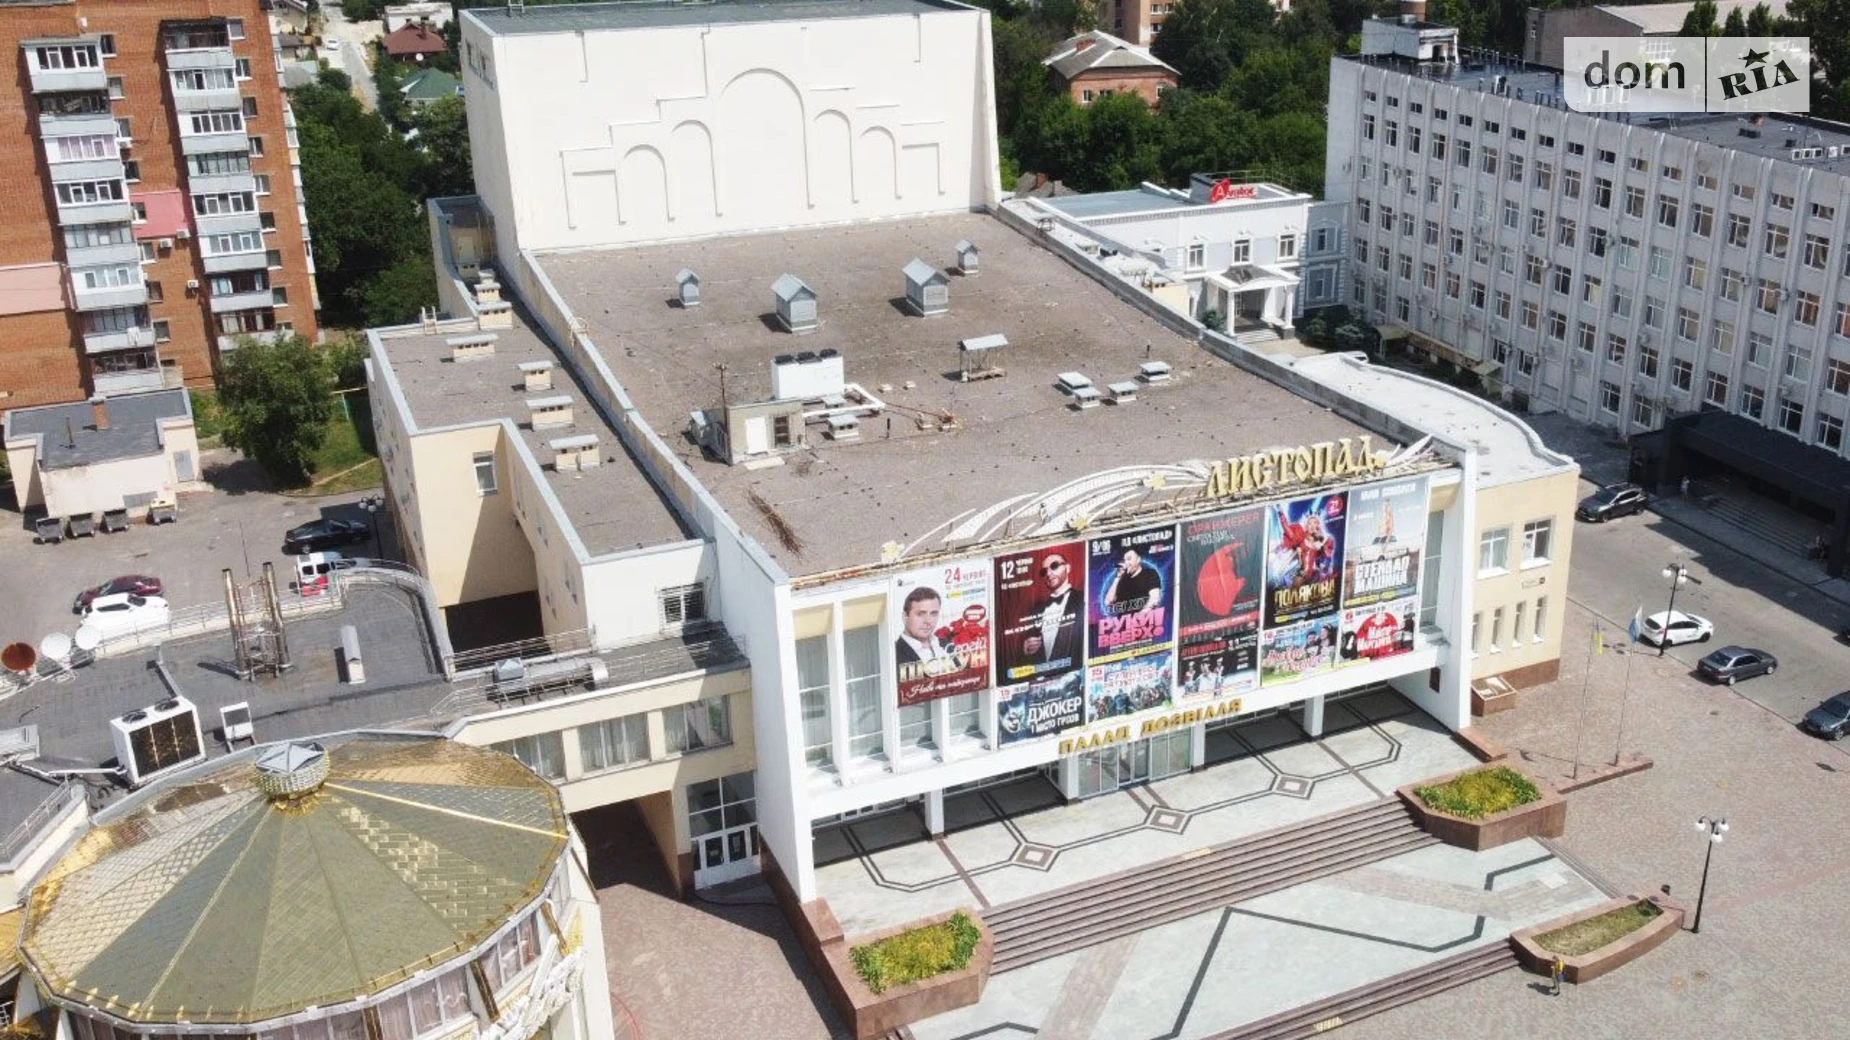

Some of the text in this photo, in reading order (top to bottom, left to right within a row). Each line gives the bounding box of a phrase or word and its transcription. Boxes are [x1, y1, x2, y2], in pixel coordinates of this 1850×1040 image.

[945, 567, 961, 584] 24
[1001, 560, 1015, 579] 12
[1275, 579, 1335, 607] ПОЛЯКОВА
[1027, 697, 1082, 725] ДЖОКЕР
[1140, 698, 1243, 736] ДОЗВІЛЛЯ
